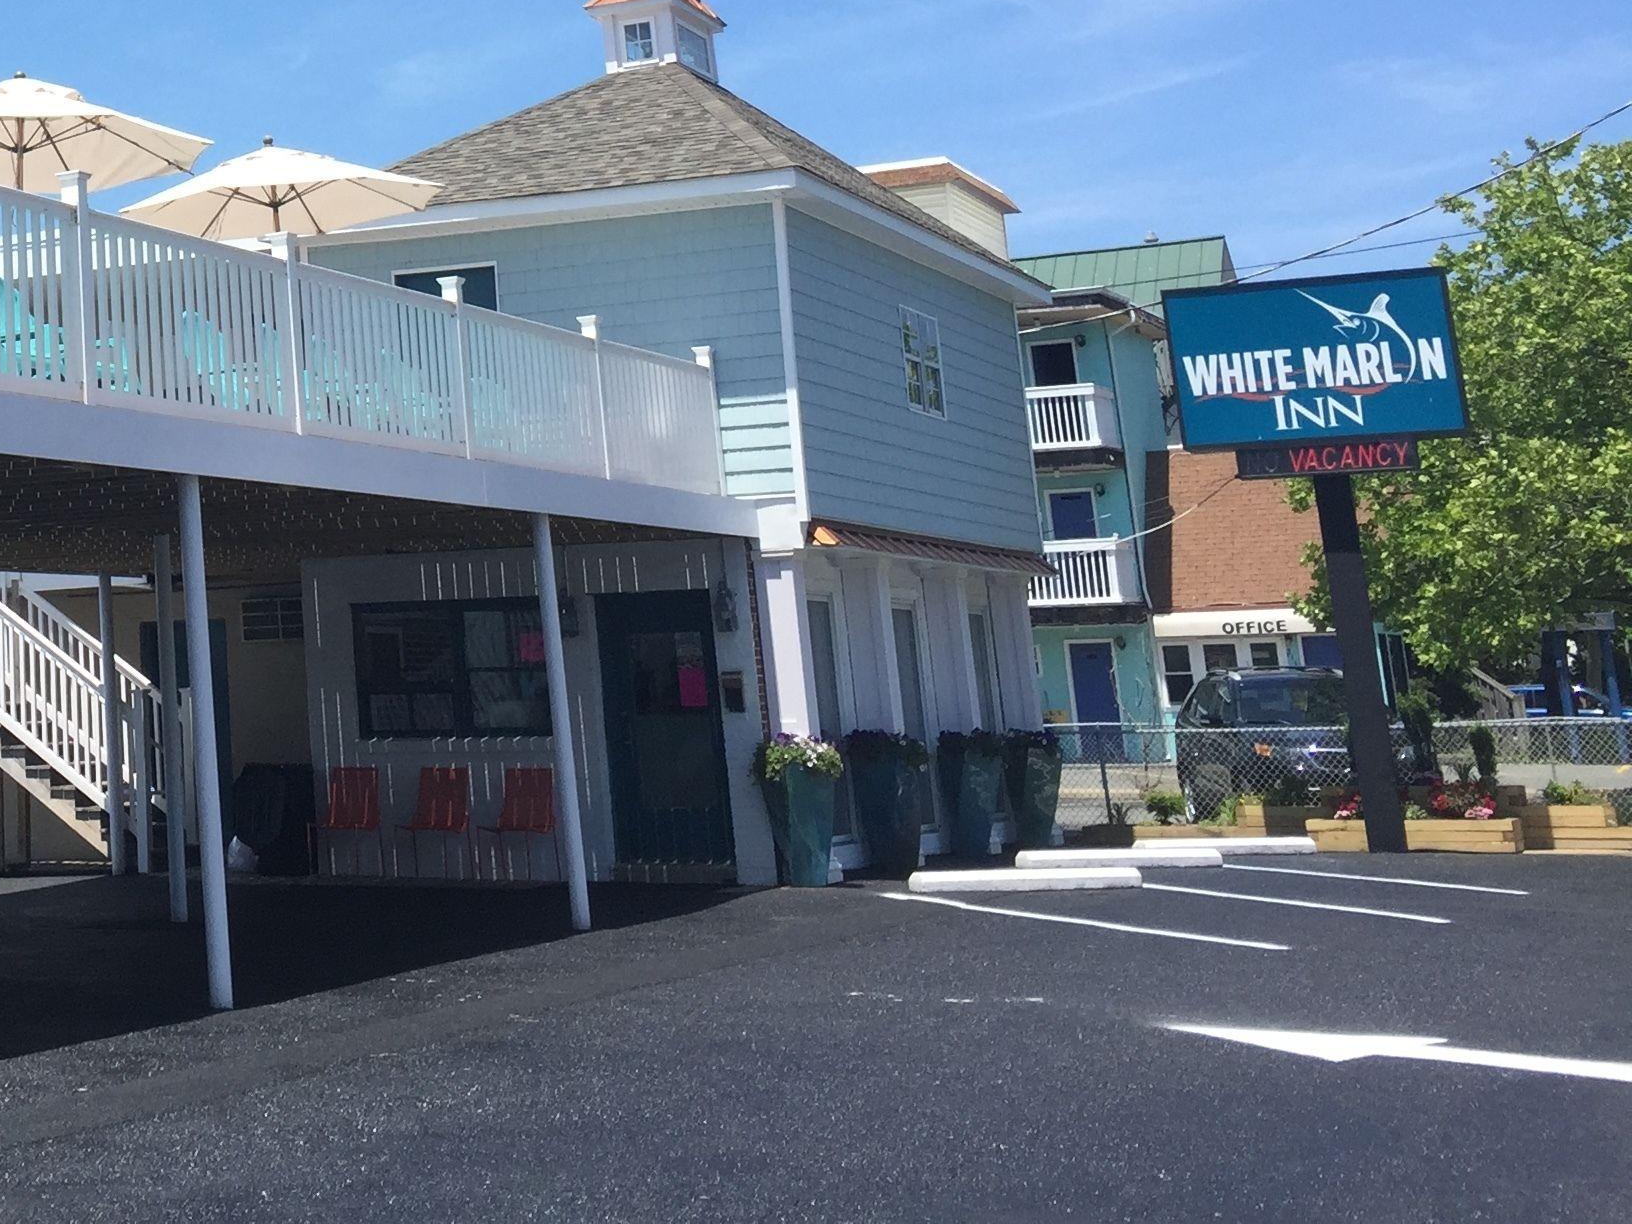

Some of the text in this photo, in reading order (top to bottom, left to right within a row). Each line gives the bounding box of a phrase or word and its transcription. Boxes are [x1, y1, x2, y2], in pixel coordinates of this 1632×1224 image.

[1183, 348, 1297, 397] WHITE
[1272, 394, 1364, 431] INN
[1288, 441, 1409, 473] VACANCY
[1221, 619, 1288, 635] OFFICE
